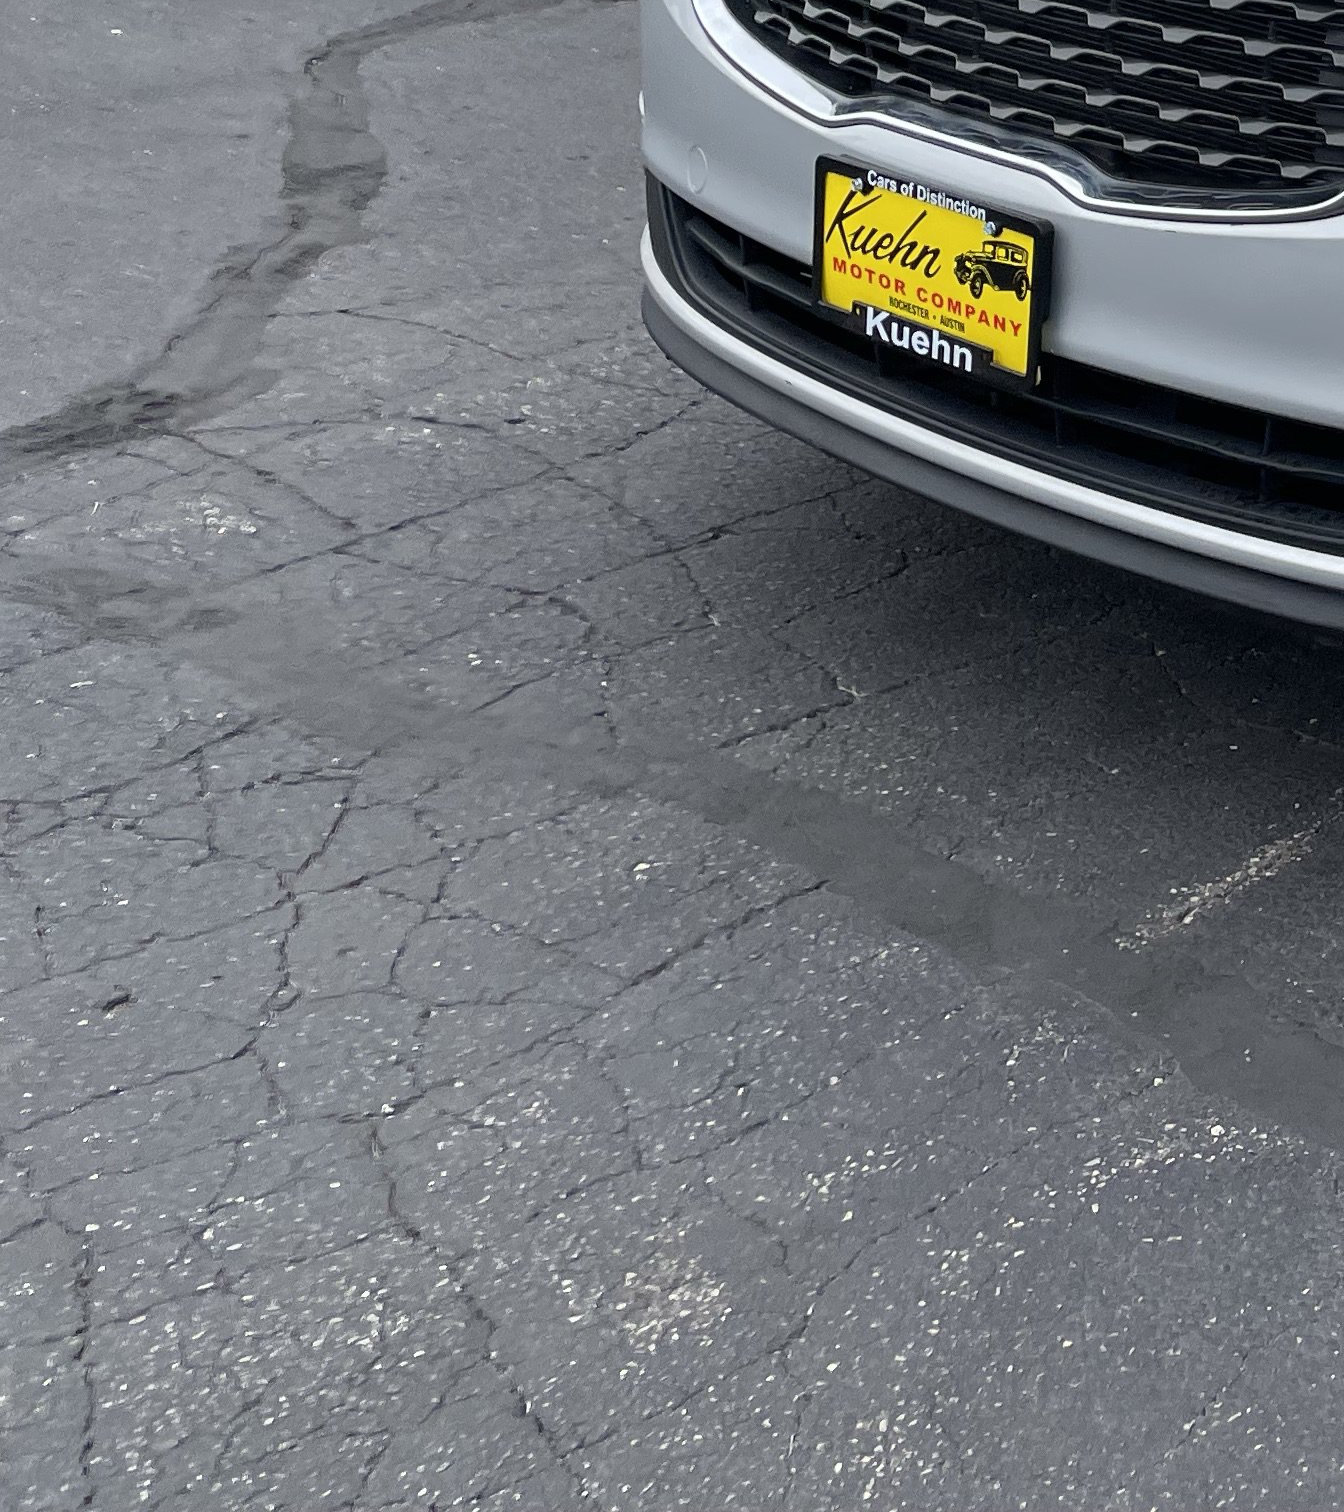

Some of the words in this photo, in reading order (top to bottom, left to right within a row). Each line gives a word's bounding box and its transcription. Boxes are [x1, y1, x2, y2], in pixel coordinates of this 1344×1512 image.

[867, 169, 898, 193] Cars
[900, 181, 914, 198] of
[917, 184, 986, 221] Distinction
[825, 190, 941, 278] Kuehn
[833, 256, 906, 296] MOTOR
[916, 287, 1023, 337] COMPANY
[889, 296, 930, 320] ROCHESTER
[940, 314, 966, 333] AUSTIN
[865, 306, 973, 372] Kuehn
